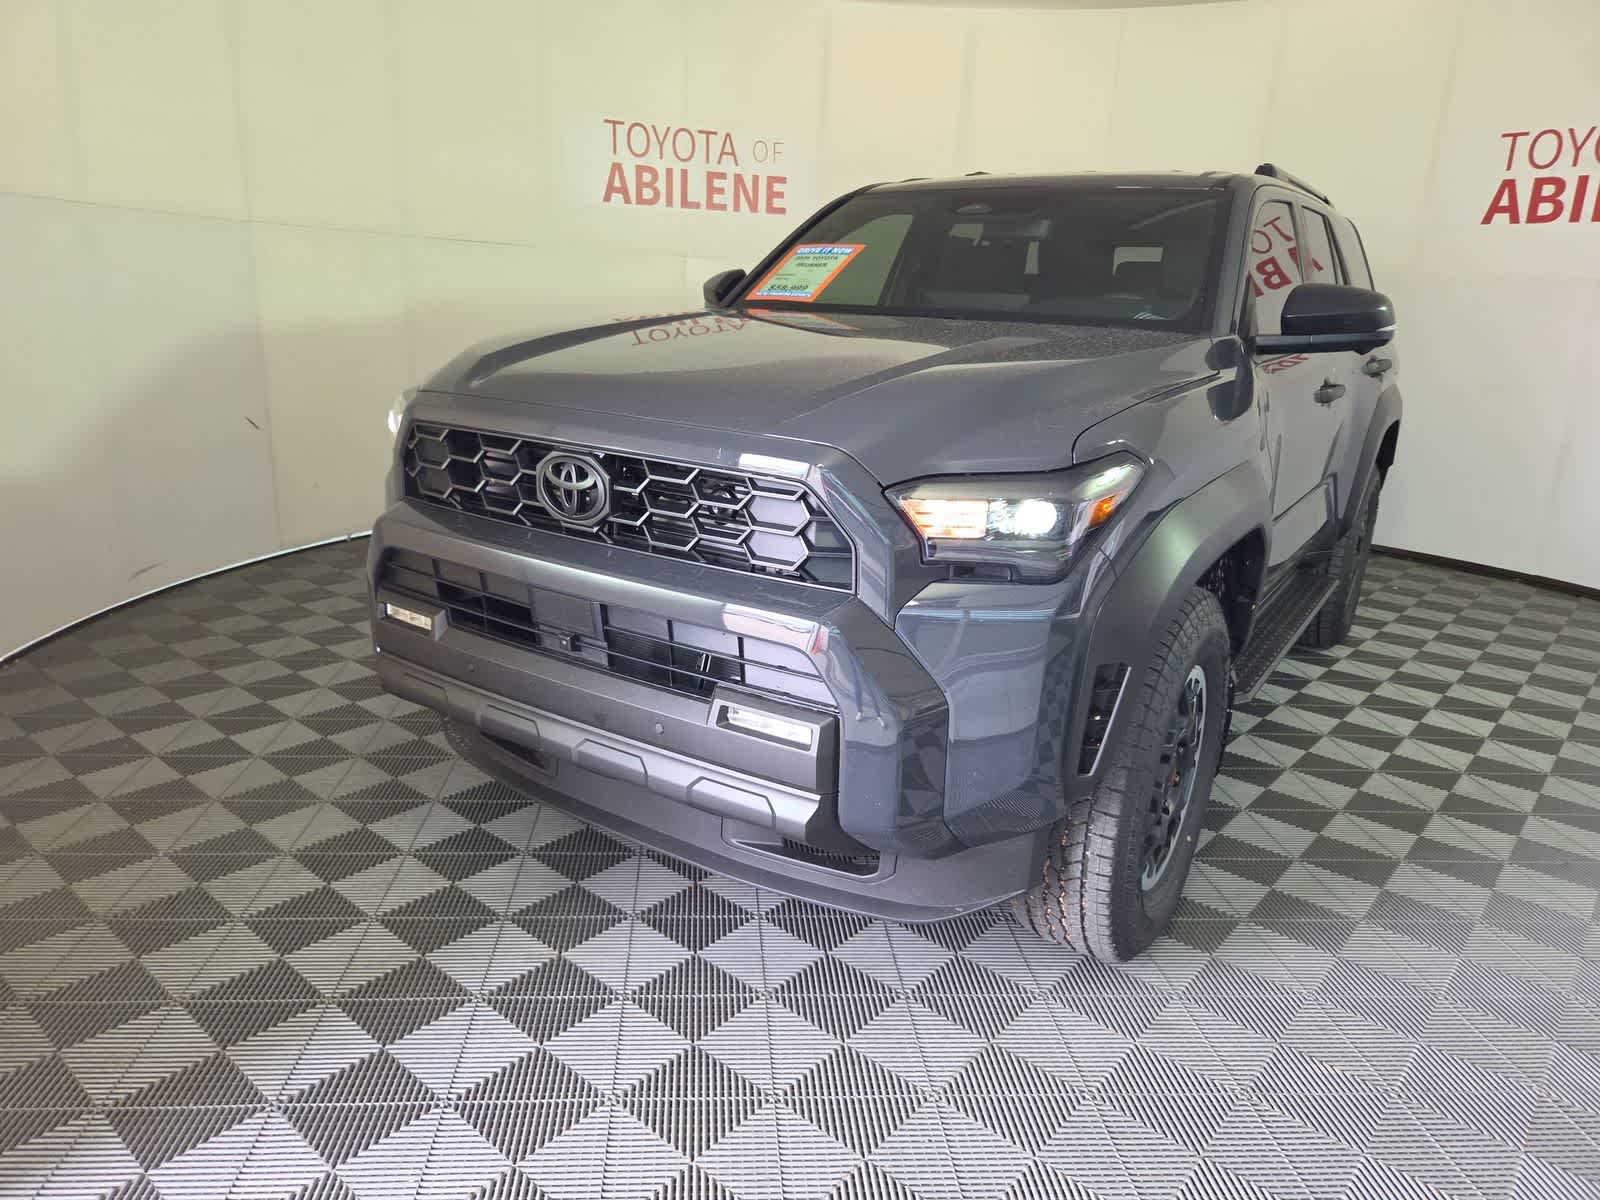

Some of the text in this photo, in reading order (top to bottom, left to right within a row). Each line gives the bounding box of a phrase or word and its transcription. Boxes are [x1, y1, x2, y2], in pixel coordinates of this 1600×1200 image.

[603, 119, 785, 167] TOYOTA OF
[1501, 126, 1600, 171] TOY
[603, 161, 787, 215] ABILENE
